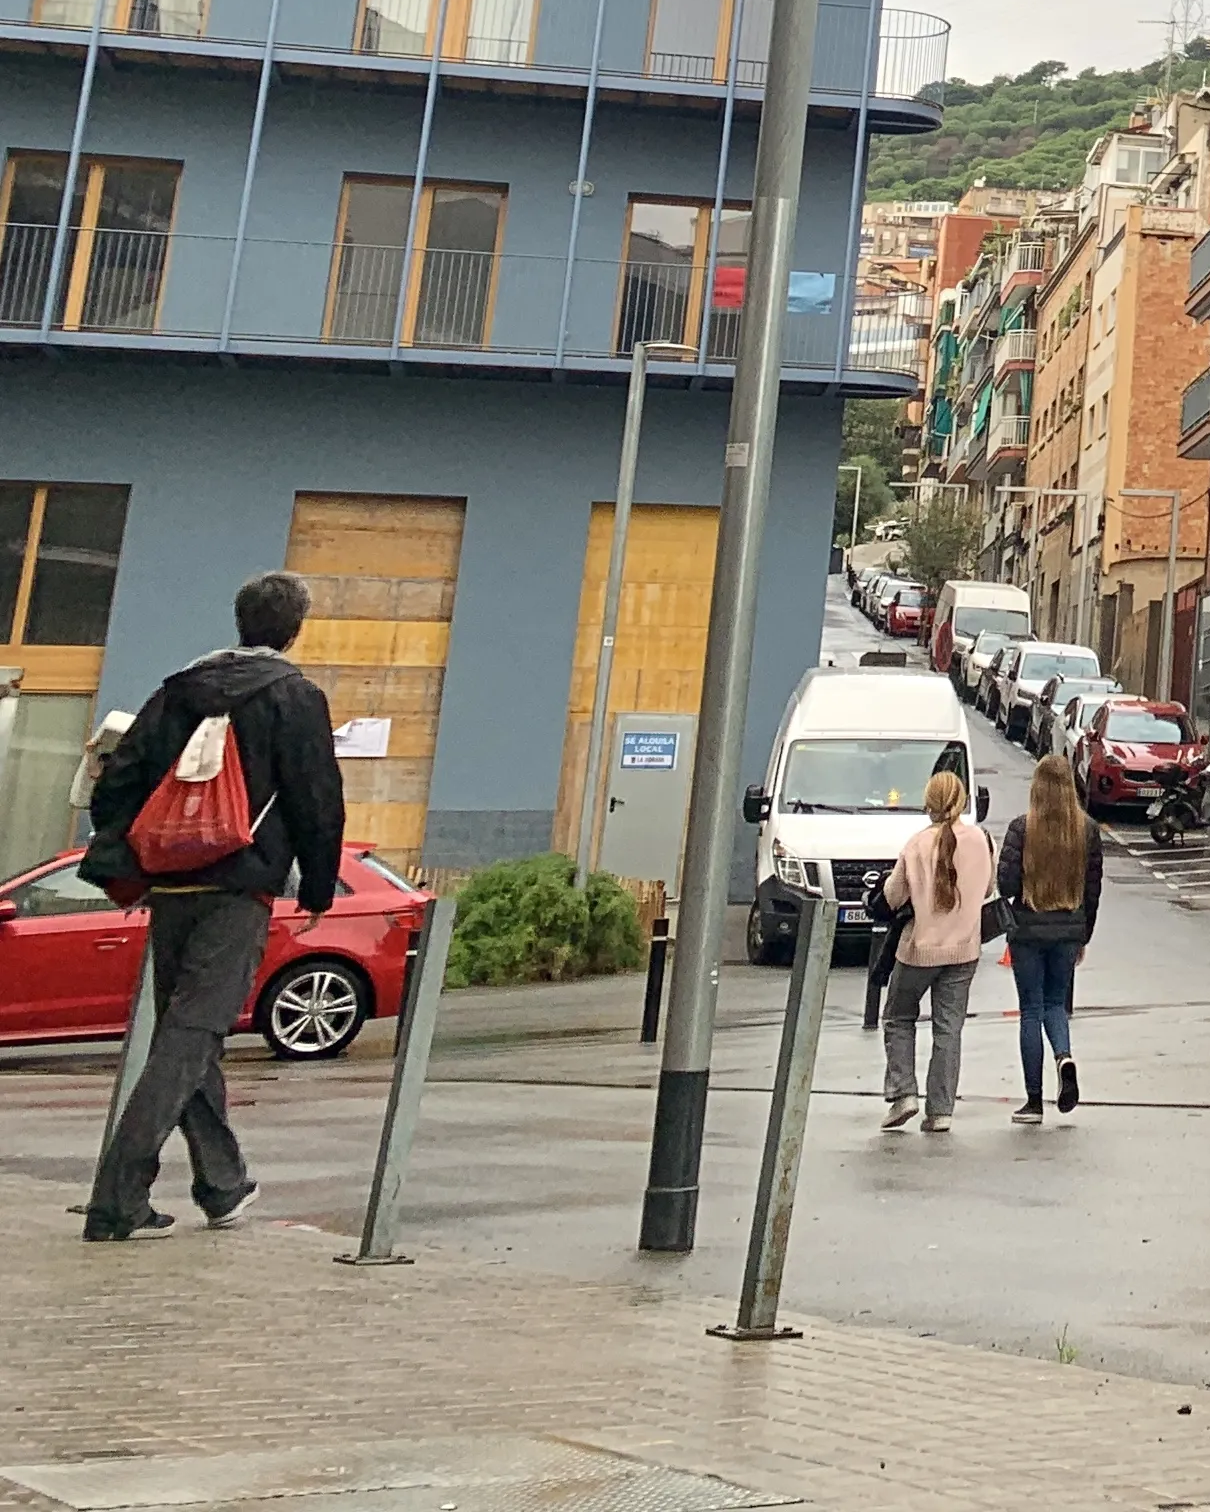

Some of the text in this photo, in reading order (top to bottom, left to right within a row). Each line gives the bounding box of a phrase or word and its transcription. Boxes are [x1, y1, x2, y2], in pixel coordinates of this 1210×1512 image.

[625, 737, 674, 745] SE ALQUILA
[634, 745, 663, 753] LOCAL
